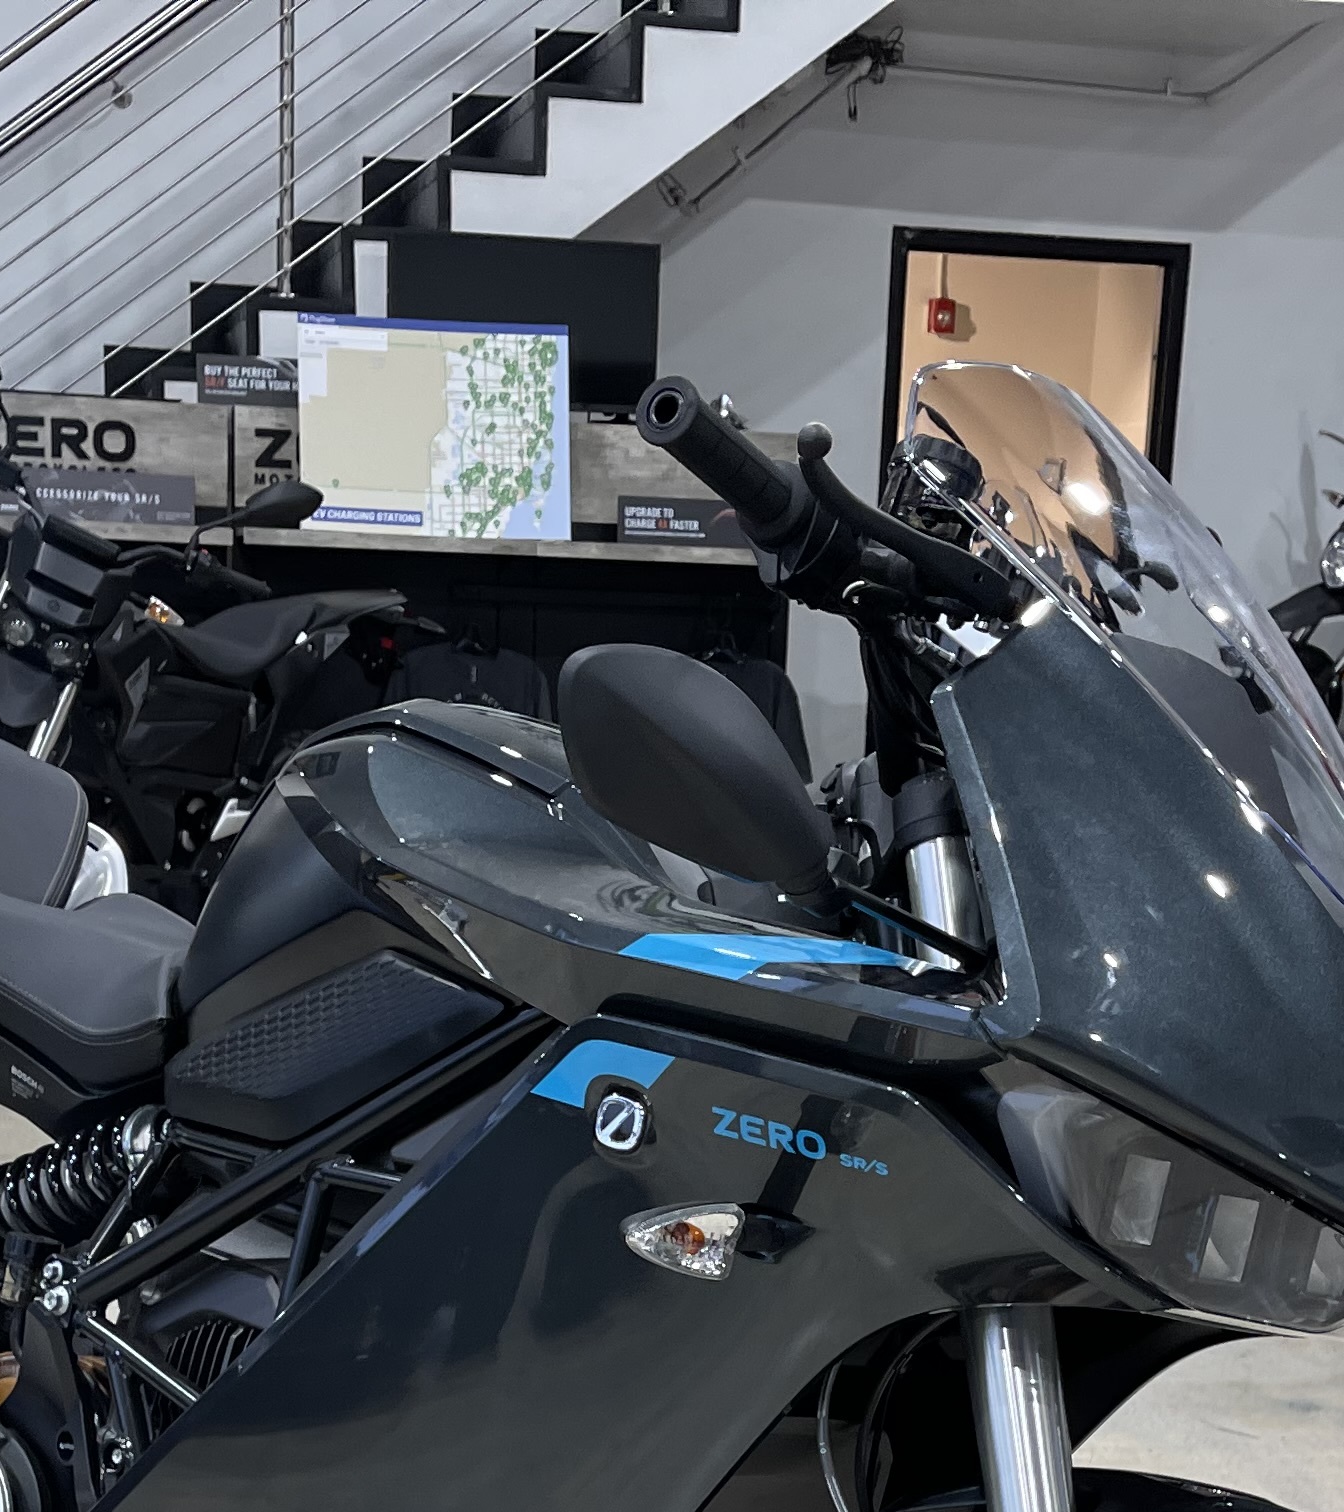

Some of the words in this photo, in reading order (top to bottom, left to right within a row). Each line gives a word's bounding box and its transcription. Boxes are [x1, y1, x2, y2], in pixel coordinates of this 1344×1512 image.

[204, 364, 222, 376] BUY
[223, 365, 240, 377] THE
[241, 366, 277, 379] PERFECT
[227, 377, 248, 389] SEAT
[249, 379, 267, 391] FOR
[268, 379, 291, 391] YOUR
[35, 487, 99, 500] CCESSORIZE
[326, 509, 375, 521] CHARGING
[376, 511, 421, 523] STATIONS
[624, 506, 662, 517] UPGRADE
[663, 507, 674, 518] TO
[624, 518, 656, 529] CHARGE
[669, 520, 700, 531] FASTER
[11, 1064, 38, 1090] BOSCH
[711, 1106, 827, 1160] ZERO
[839, 1153, 889, 1176] SR/S
